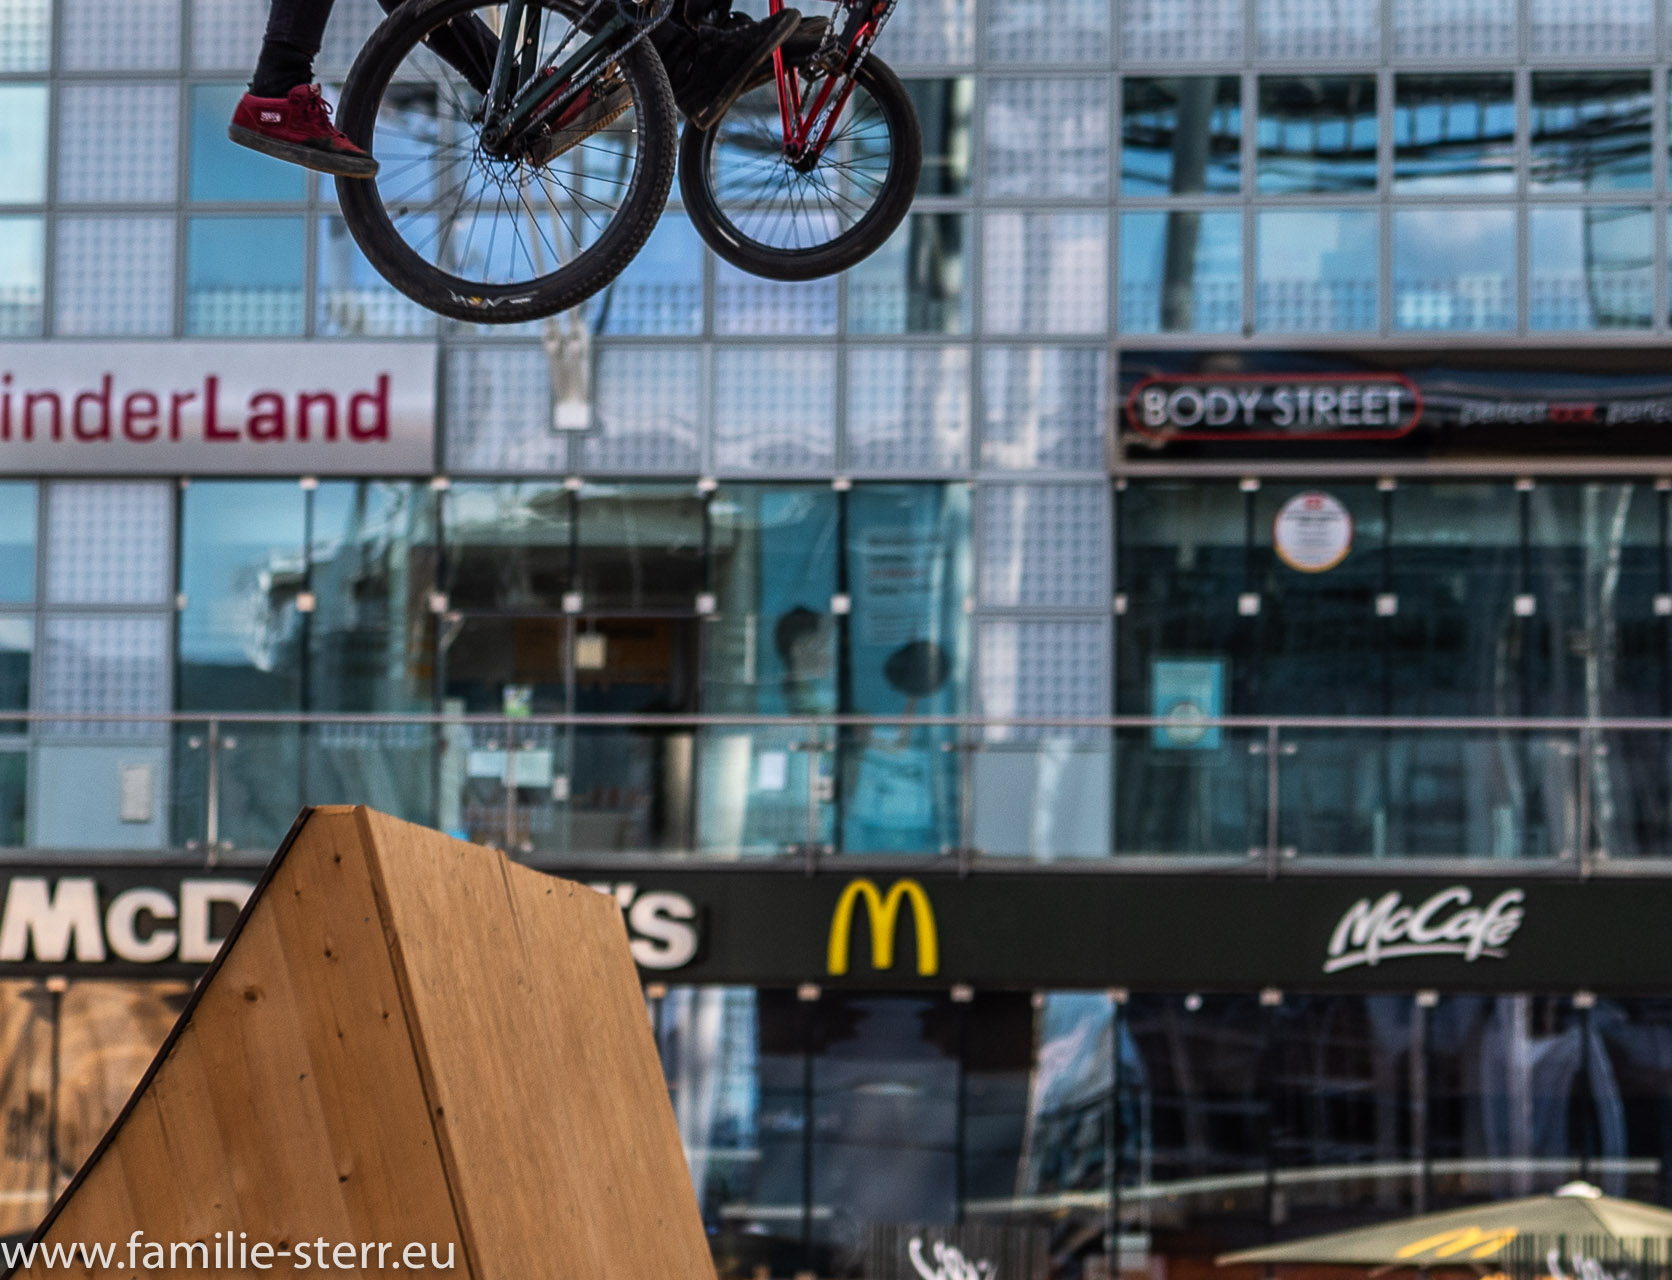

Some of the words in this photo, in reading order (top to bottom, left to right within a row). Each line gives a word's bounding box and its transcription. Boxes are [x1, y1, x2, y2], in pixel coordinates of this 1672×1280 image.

[1142, 386, 1263, 427] BODY
[1271, 386, 1402, 426] STREET
[1325, 884, 1526, 966] McCafé
